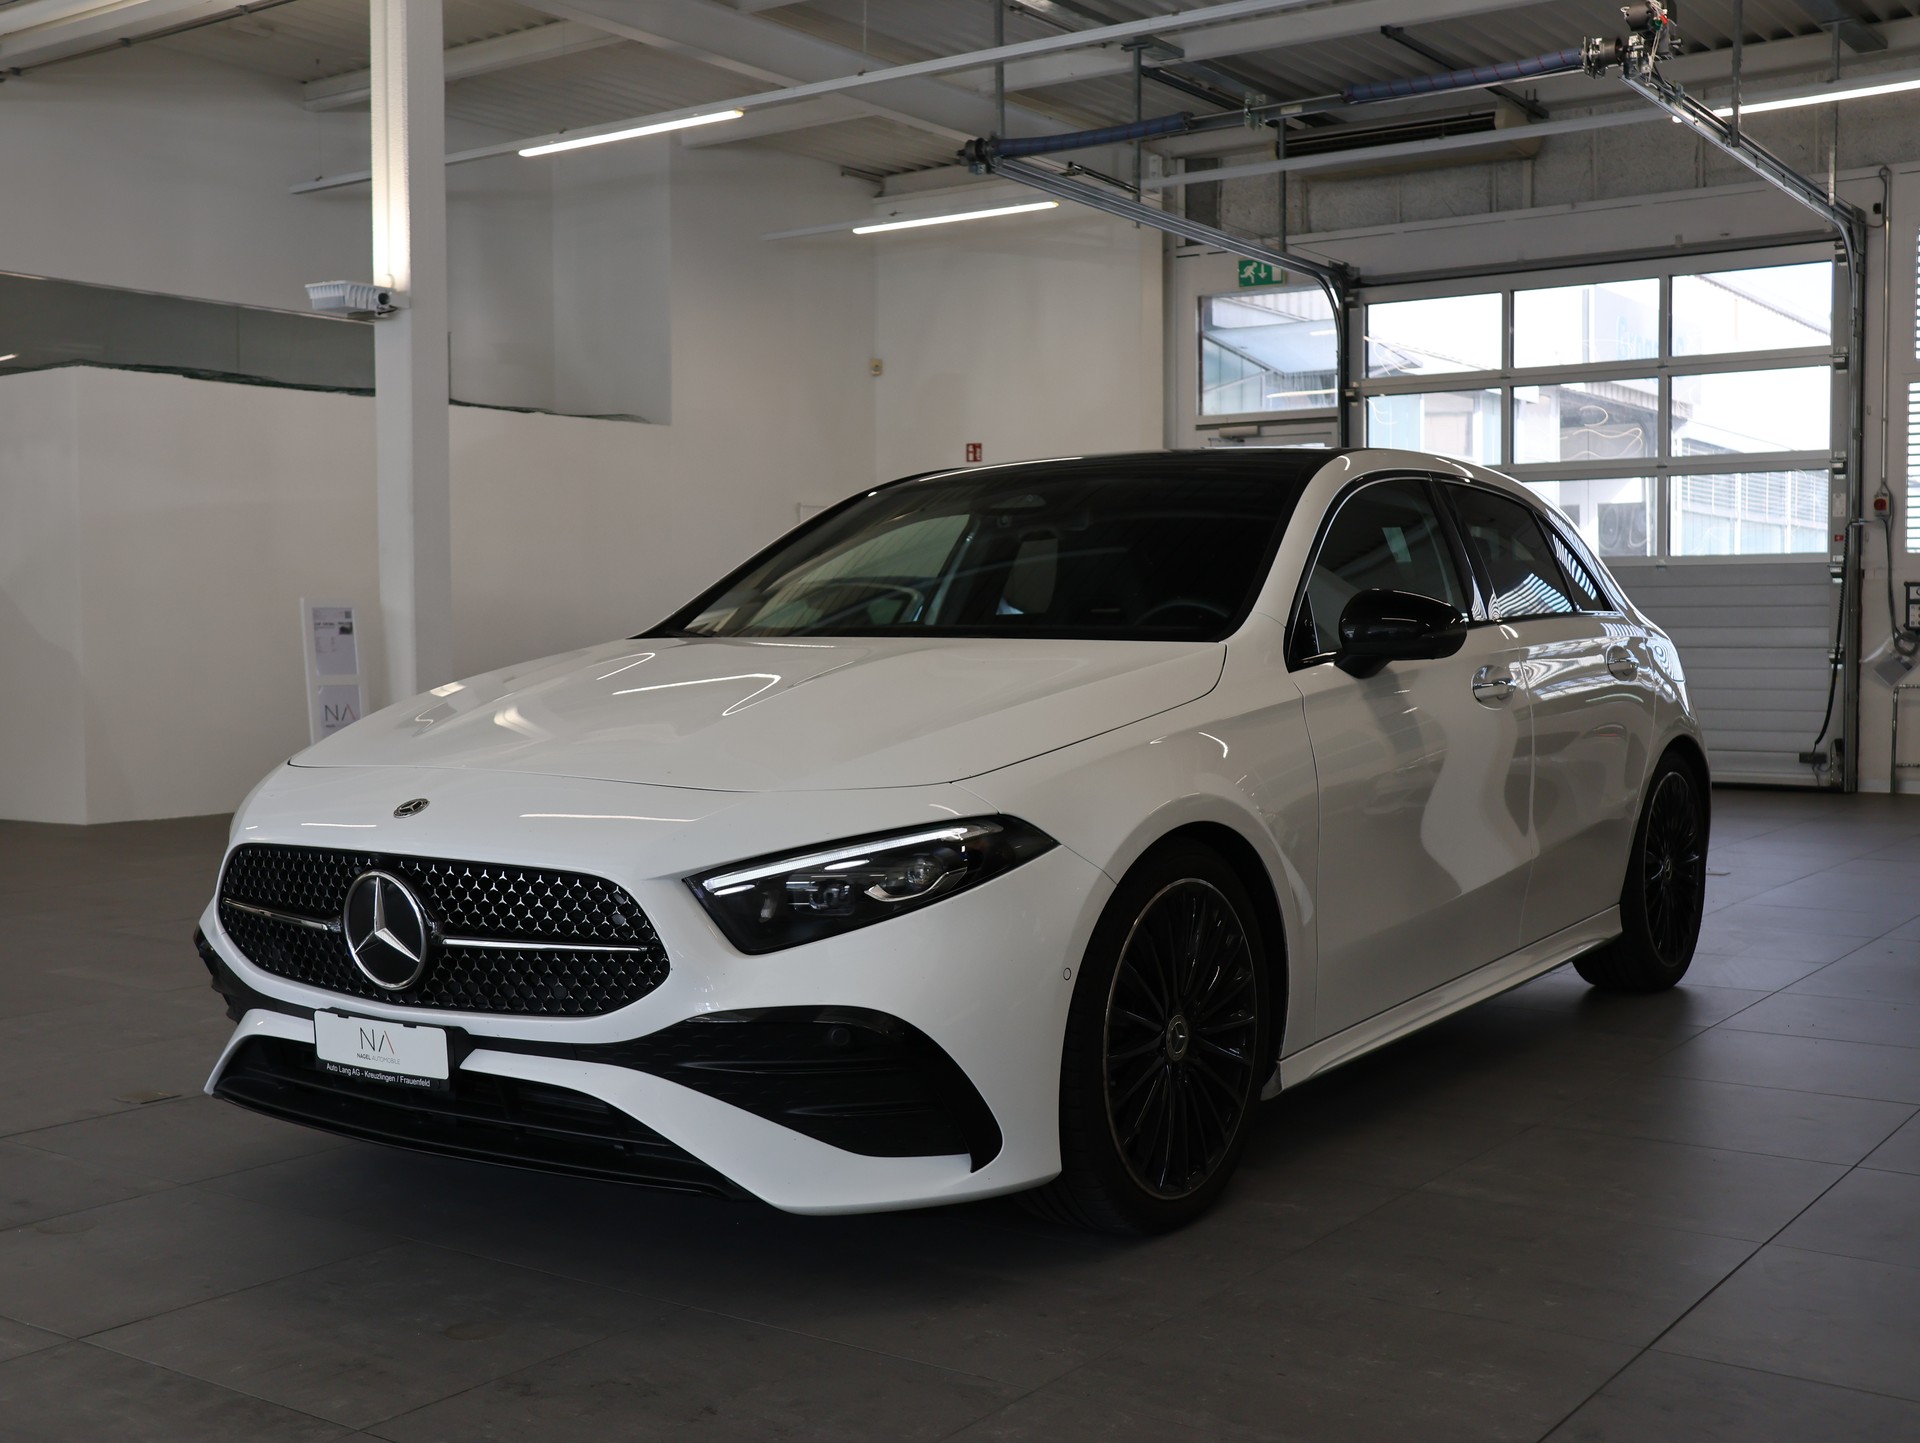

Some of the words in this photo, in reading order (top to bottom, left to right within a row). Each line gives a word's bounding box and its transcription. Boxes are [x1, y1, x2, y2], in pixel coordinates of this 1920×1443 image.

[324, 703, 357, 722] NA
[359, 1027, 395, 1055] NA
[357, 1053, 371, 1061] NAGEL
[372, 1056, 400, 1065] AUTOMOBILE
[326, 1063, 338, 1073] Auto
[339, 1065, 351, 1076] Lang
[351, 1067, 361, 1077] AG
[364, 1070, 396, 1082] Kreuzlingen
[399, 1075, 431, 1087] Frauenfeld
